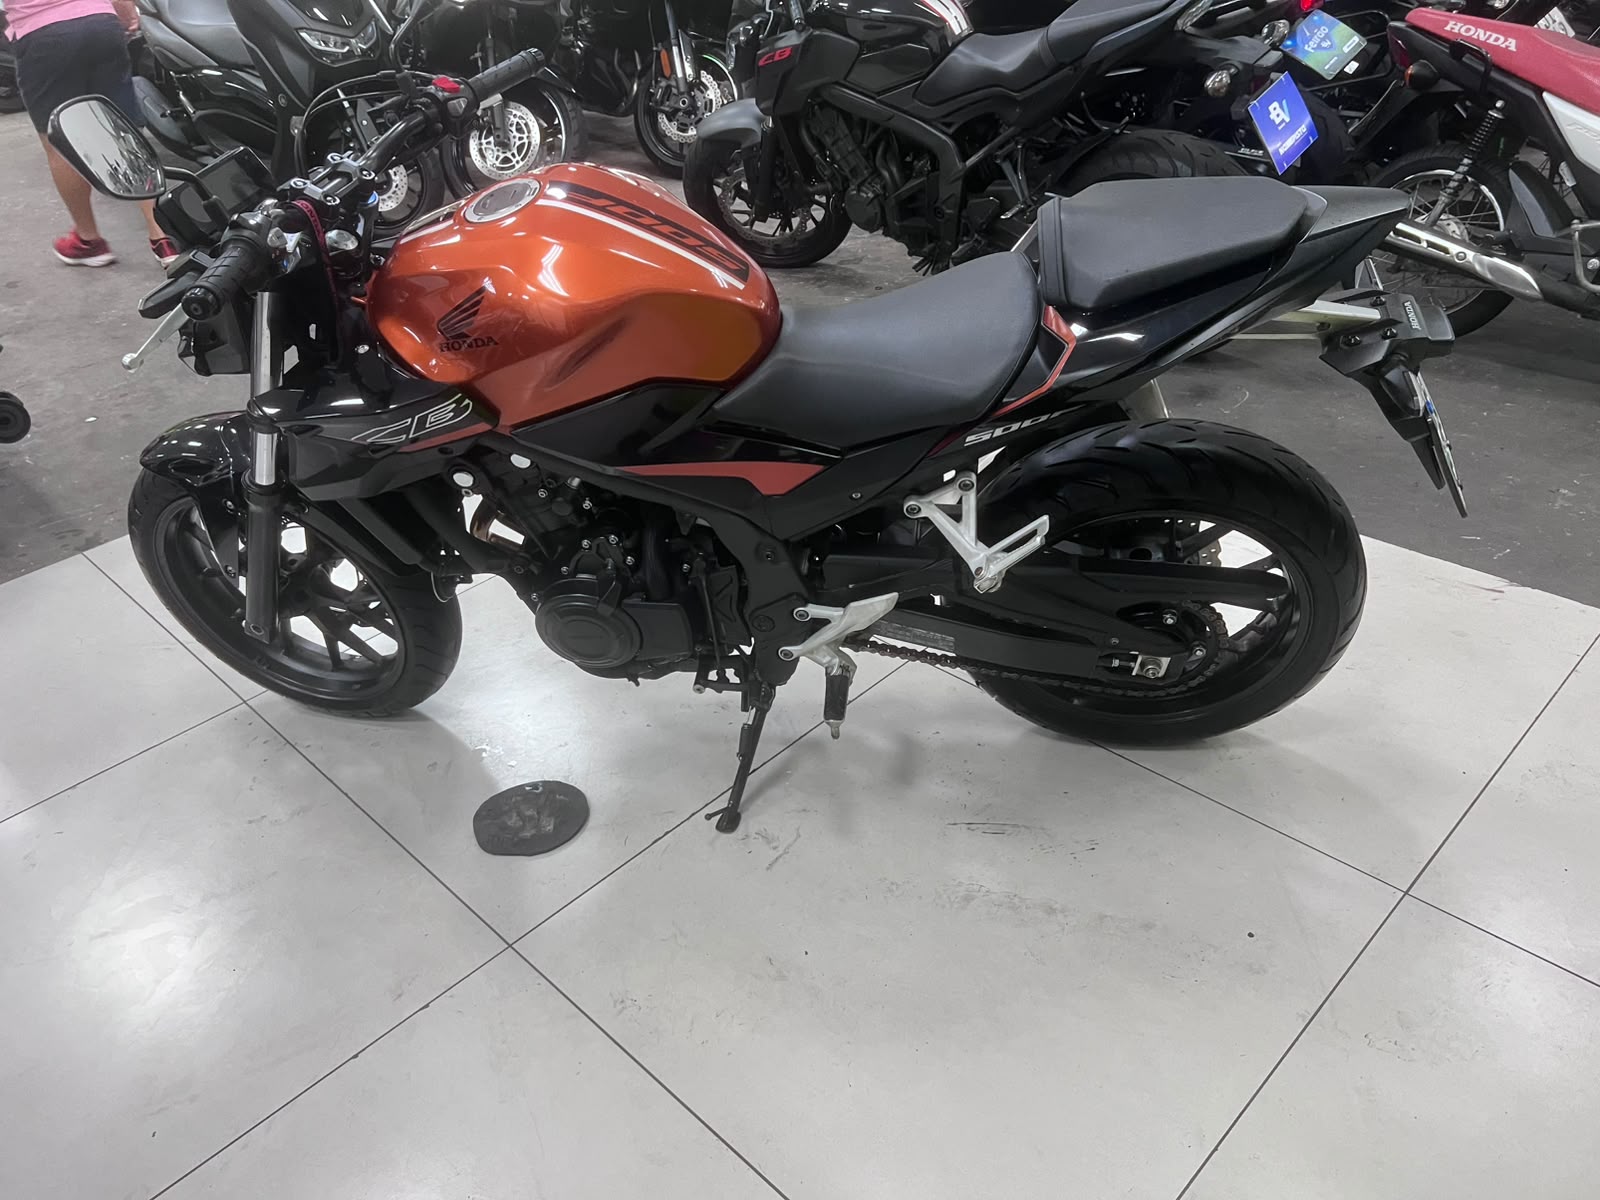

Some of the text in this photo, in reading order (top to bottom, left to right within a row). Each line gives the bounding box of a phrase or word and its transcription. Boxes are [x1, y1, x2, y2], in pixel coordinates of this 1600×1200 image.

[1304, 26, 1329, 53] Feirão
[1444, 21, 1517, 51] HONDA
[758, 47, 792, 67] CB
[1404, 301, 1422, 331] HONDA
[439, 336, 499, 352] HONDA
[351, 393, 473, 445] CB
